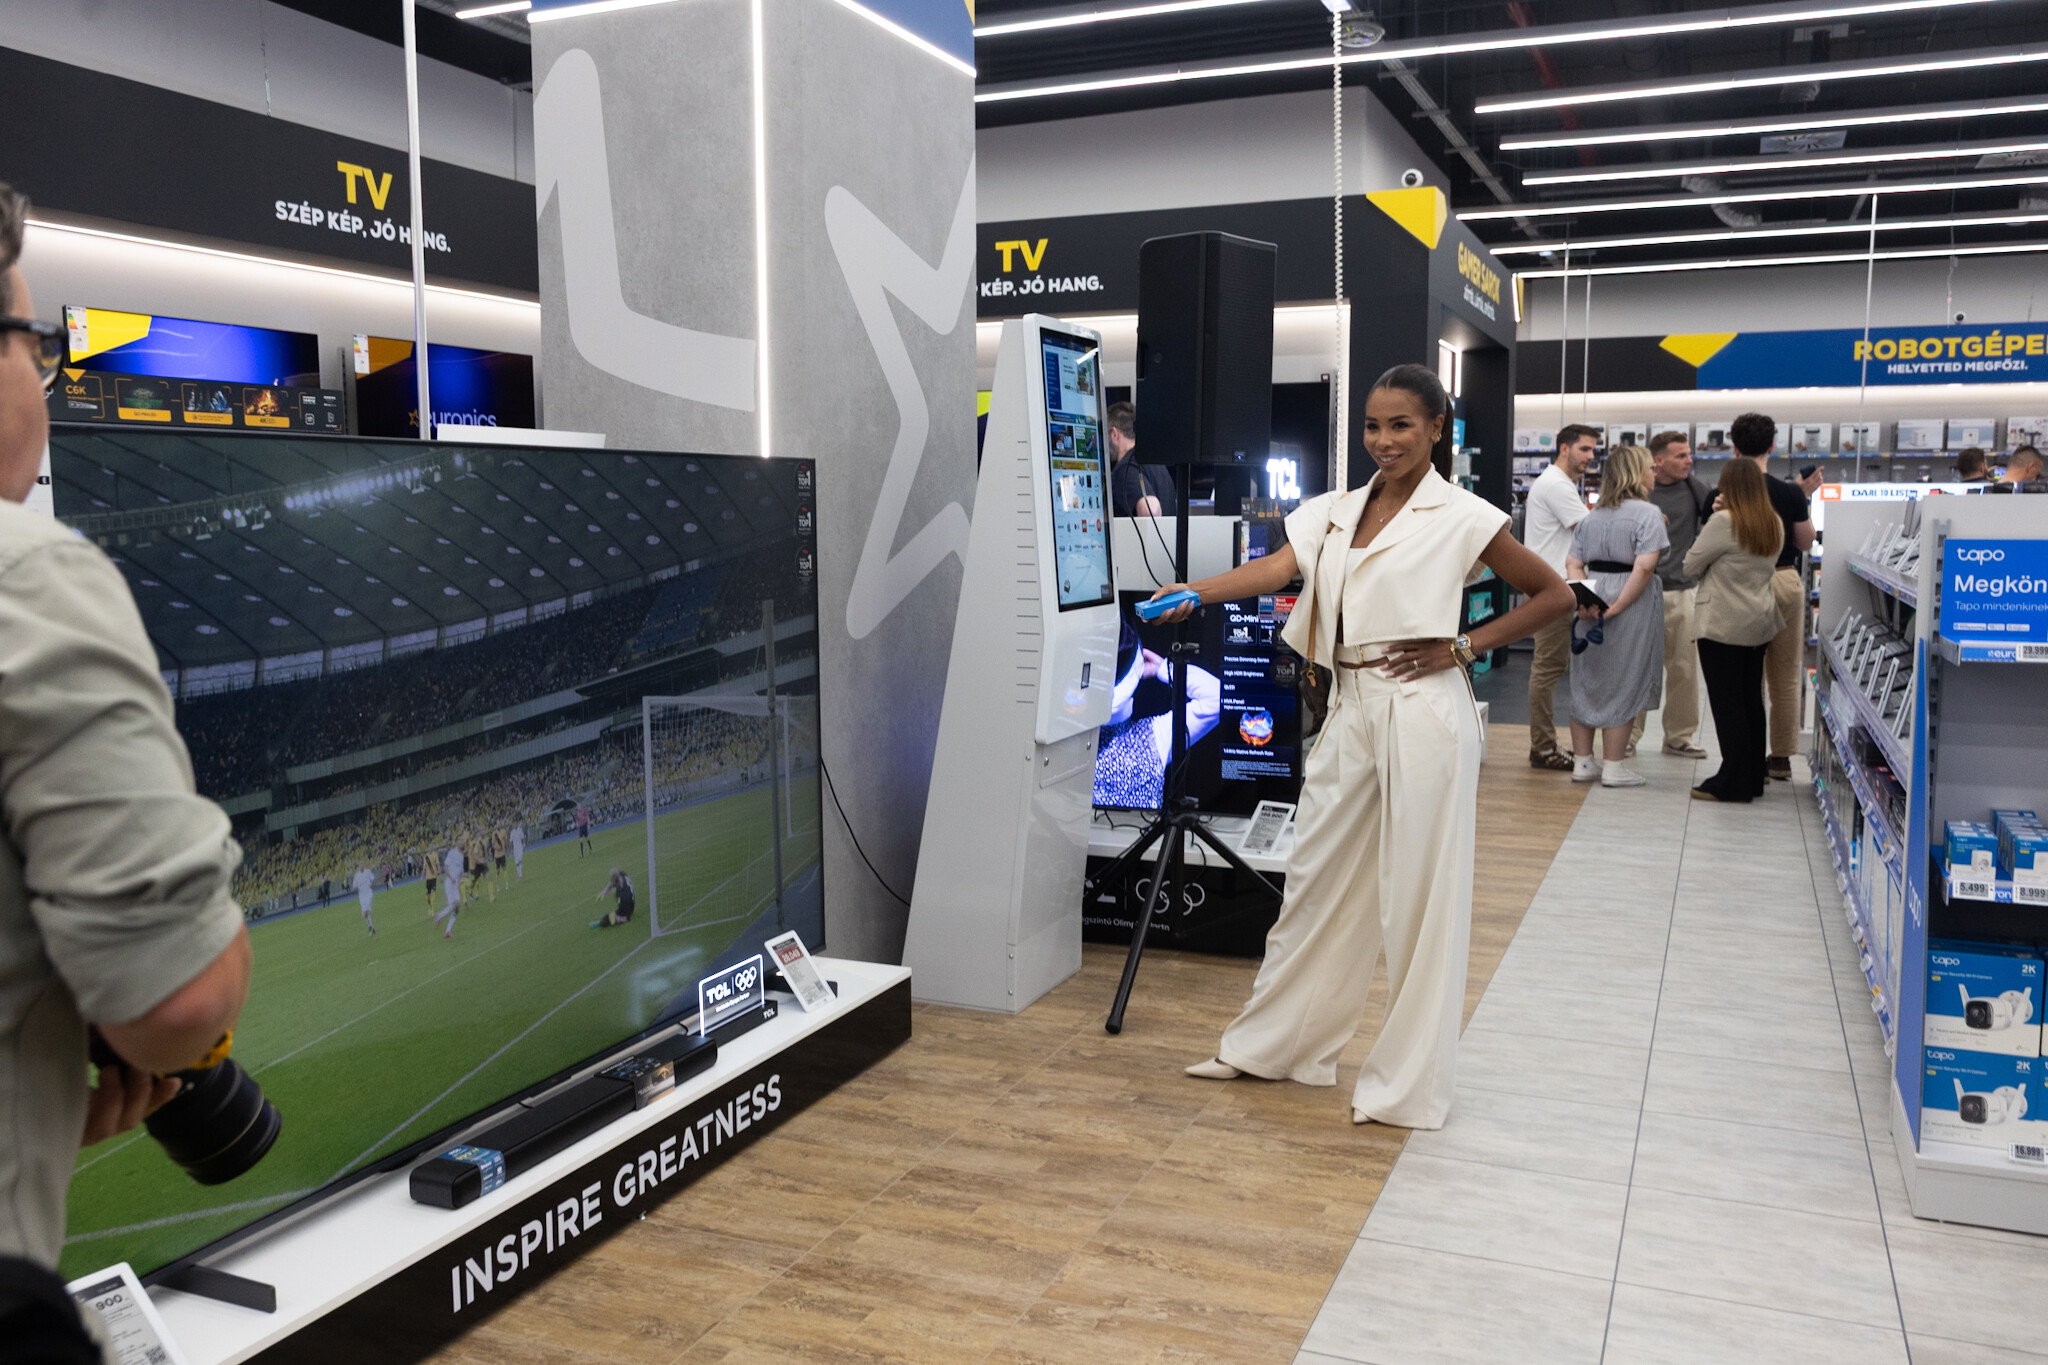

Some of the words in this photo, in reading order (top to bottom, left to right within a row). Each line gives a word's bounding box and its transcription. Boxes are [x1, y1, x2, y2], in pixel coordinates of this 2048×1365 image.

[337, 160, 393, 211] TV
[275, 200, 325, 227] SZÉP
[327, 209, 367, 238] KÉP,
[370, 217, 396, 242] JÓ
[399, 225, 452, 253] HNG.
[995, 238, 1049, 273] TV
[980, 277, 1017, 297] KÉP,
[1019, 274, 1045, 295] JÓ
[1048, 275, 1104, 293] HANG.
[1853, 329, 2048, 361] ROBOTGÉPE
[1888, 361, 1962, 375] HELYETTED
[1965, 358, 2028, 373] MEGFŐZI.
[65, 385, 87, 395] C6K
[1265, 457, 1301, 501] TCL
[1851, 489, 1877, 497] DARE
[1880, 489, 1889, 497] TO
[1957, 547, 2005, 566] tapo
[1954, 574, 2048, 597] Megkön
[1223, 603, 1241, 611] TCL
[1954, 600, 1980, 612] Tapo
[1960, 882, 1985, 893] 5.499
[2020, 887, 2046, 898] 8.999
[1932, 955, 1960, 967] tapo
[2022, 964, 2036, 974] 2K
[706, 981, 731, 1005] TCL
[763, 1008, 775, 1019] TCL
[1927, 1049, 1955, 1062] tapo
[2016, 1061, 2031, 1071] 2K
[2015, 1144, 2041, 1157] 16.999
[451, 1180, 602, 1314] INSPIRE
[612, 1073, 782, 1208] GREATNESS
